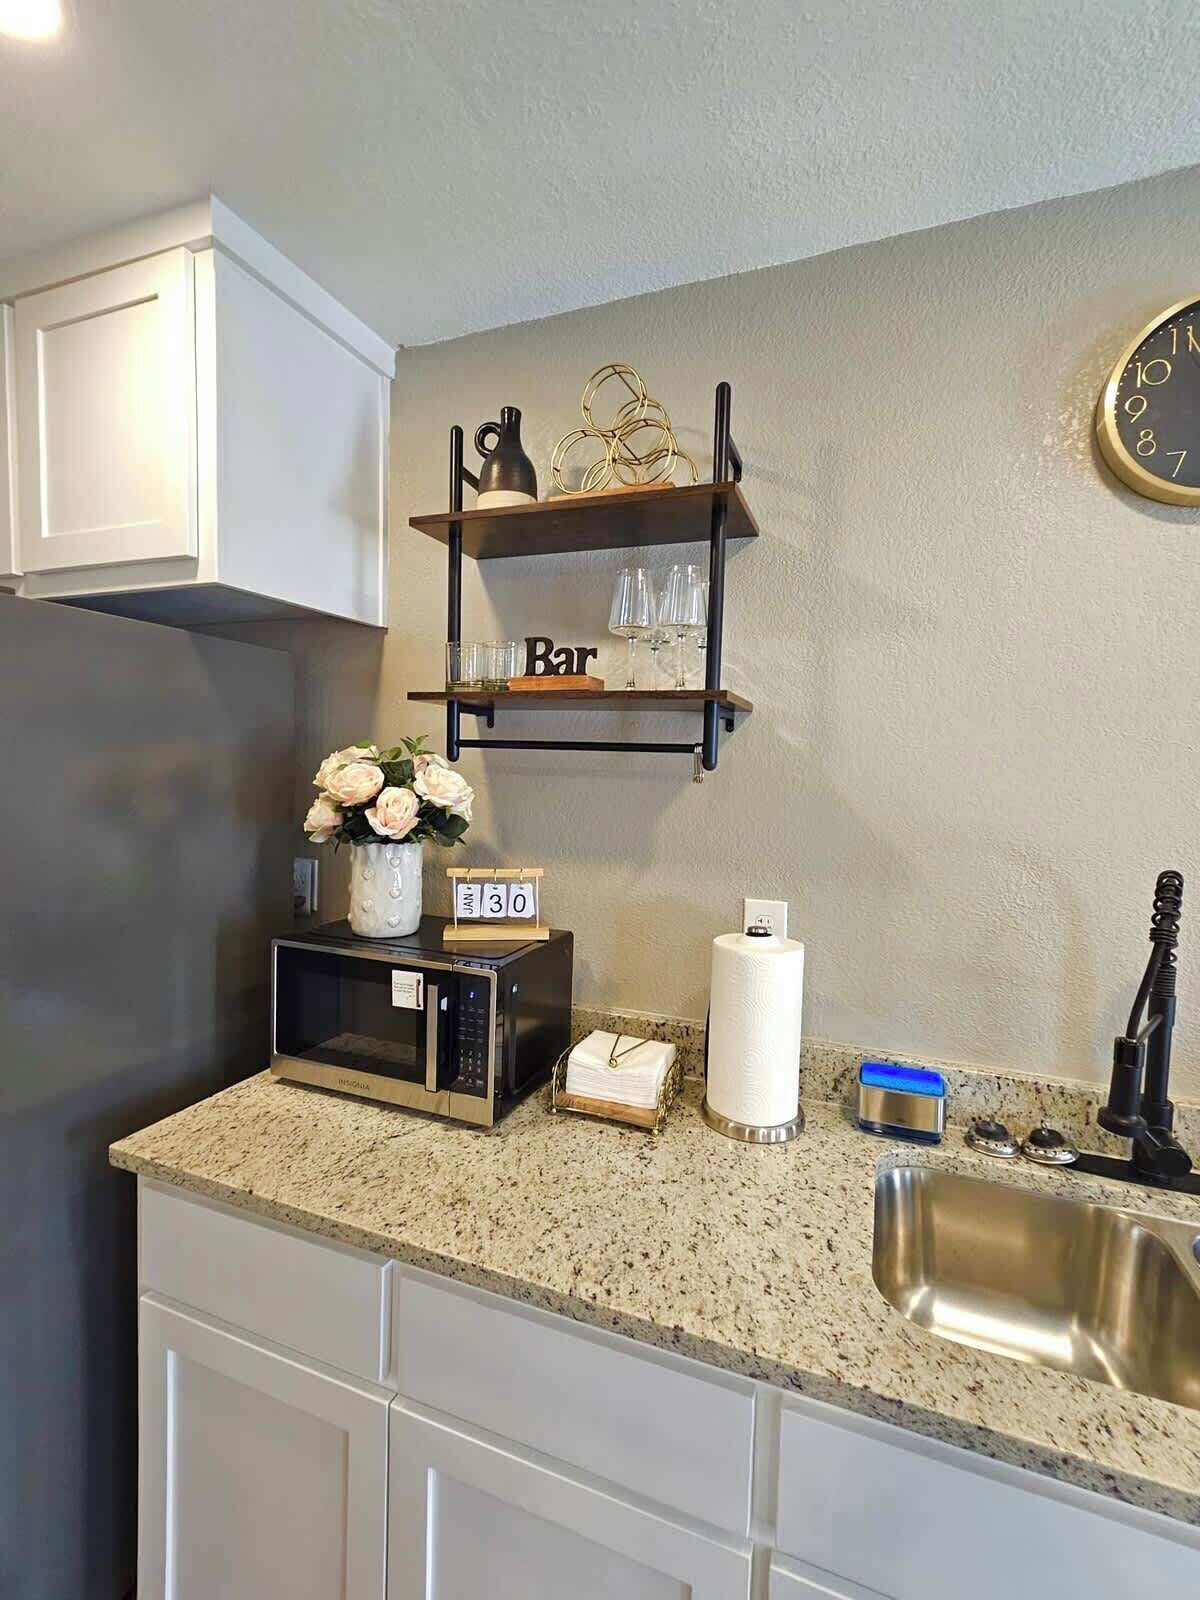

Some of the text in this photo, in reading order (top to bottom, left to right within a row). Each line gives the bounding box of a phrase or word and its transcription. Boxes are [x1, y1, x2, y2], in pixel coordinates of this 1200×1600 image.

[1136, 359, 1172, 388] 10
[1124, 395, 1147, 423] 9
[1136, 429, 1157, 456] 8
[1165, 450, 1187, 478] 7
[523, 636, 598, 676] Bar
[463, 893, 474, 914] JAN
